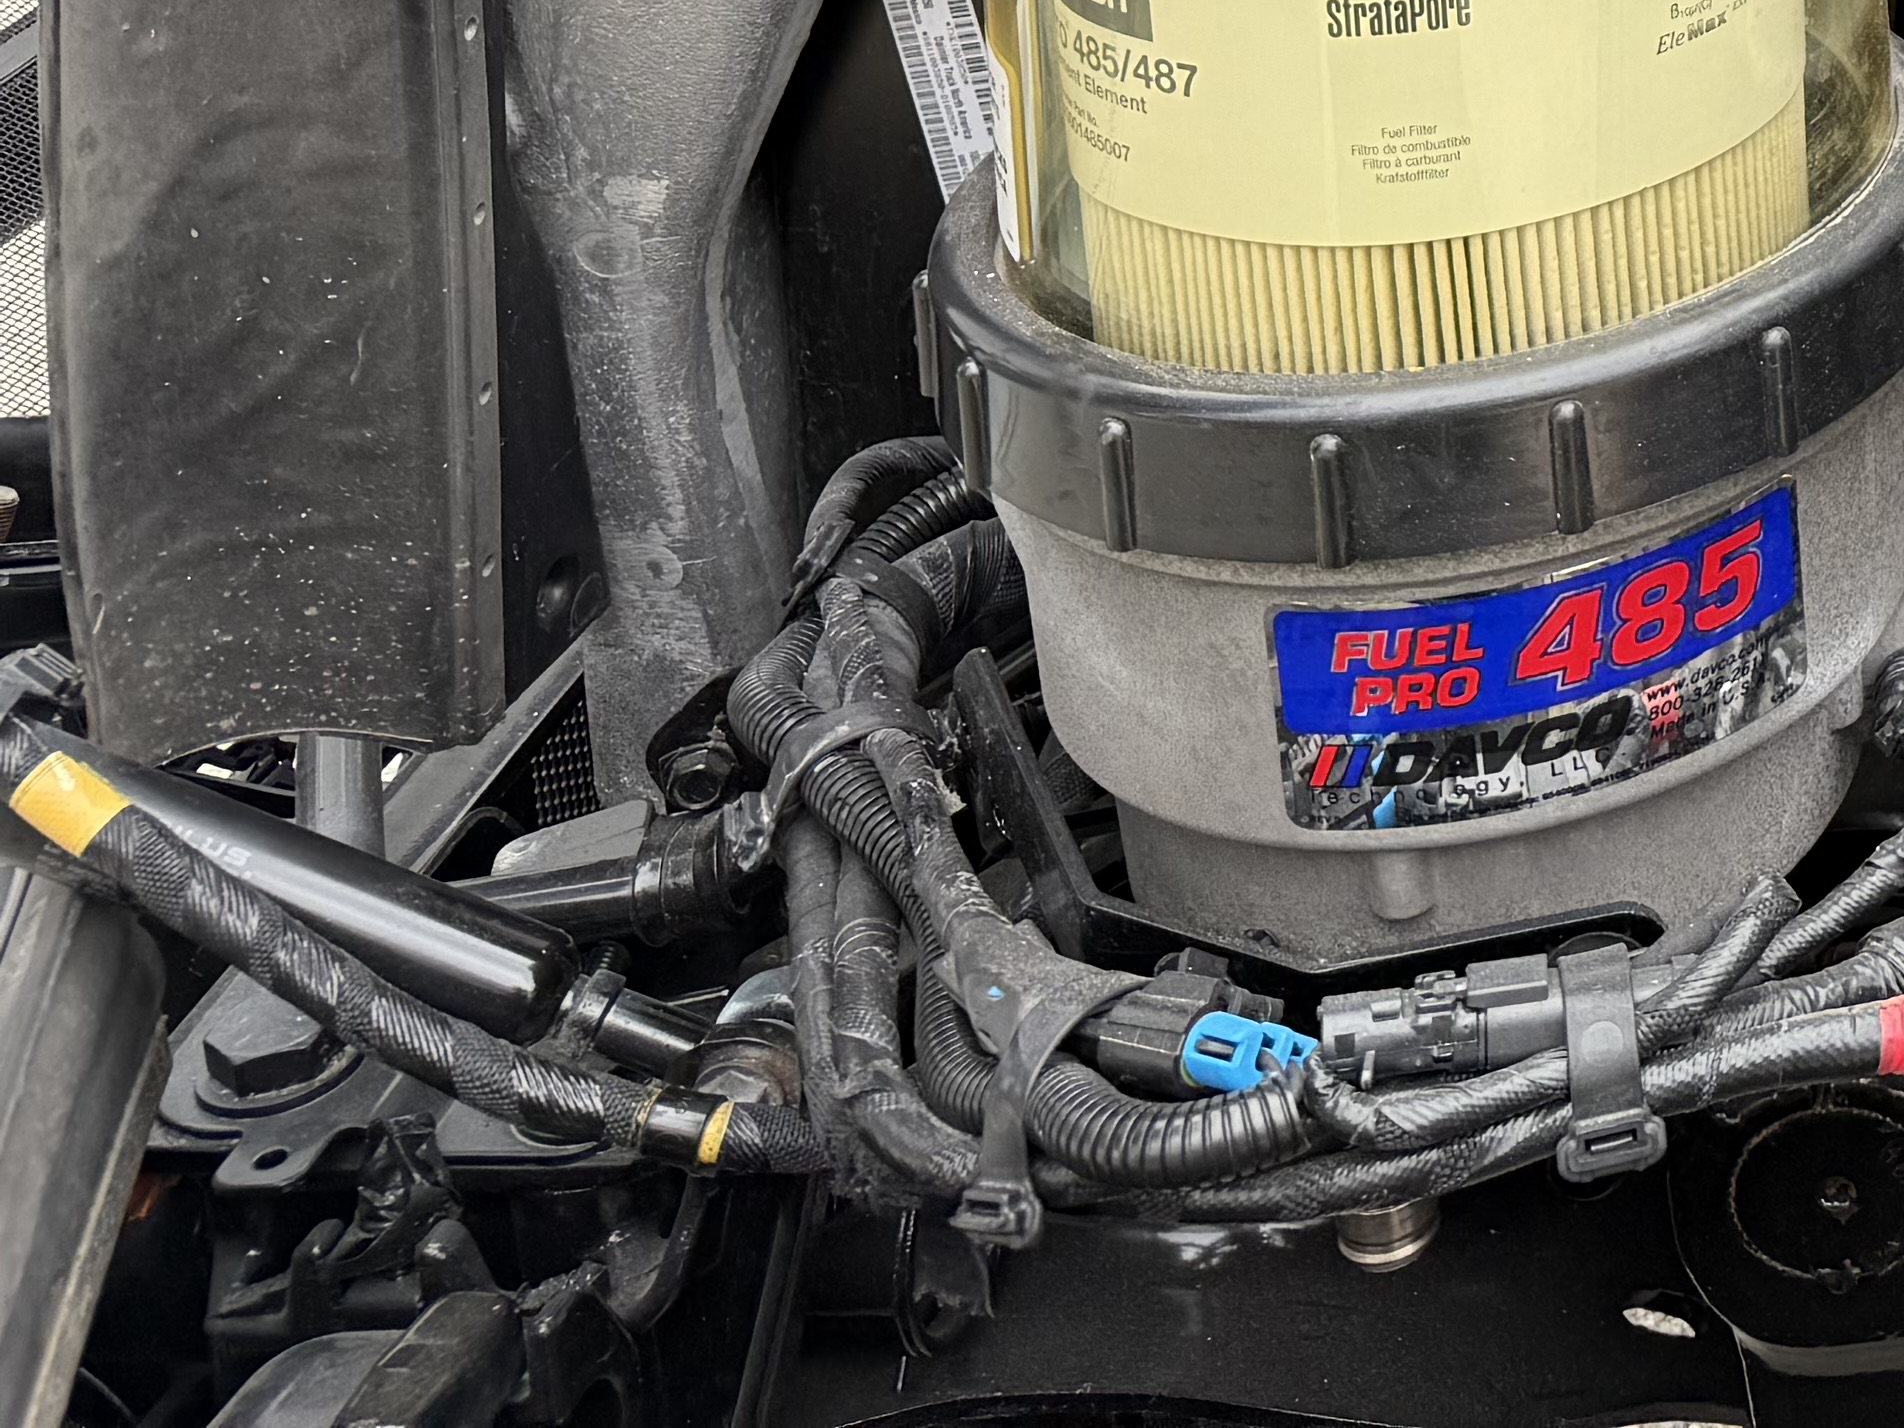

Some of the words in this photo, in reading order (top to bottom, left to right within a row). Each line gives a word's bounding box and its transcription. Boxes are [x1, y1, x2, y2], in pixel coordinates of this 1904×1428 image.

[1073, 29, 1198, 98] 485/487
[1084, 74, 1148, 114] Element
[1351, 143, 1380, 157] Filtro
[1383, 142, 1397, 155] de
[1400, 135, 1472, 154] combustible
[1381, 126, 1406, 139] Fuel
[1409, 124, 1438, 137] Filter
[1394, 156, 1403, 168] à
[1405, 150, 1462, 167] carburant
[1331, 622, 1485, 674] FUEL
[1514, 520, 1763, 692] 485
[1350, 666, 1482, 717] PRO
[1701, 700, 1716, 718] in
[1372, 694, 1634, 787] DAVCO
